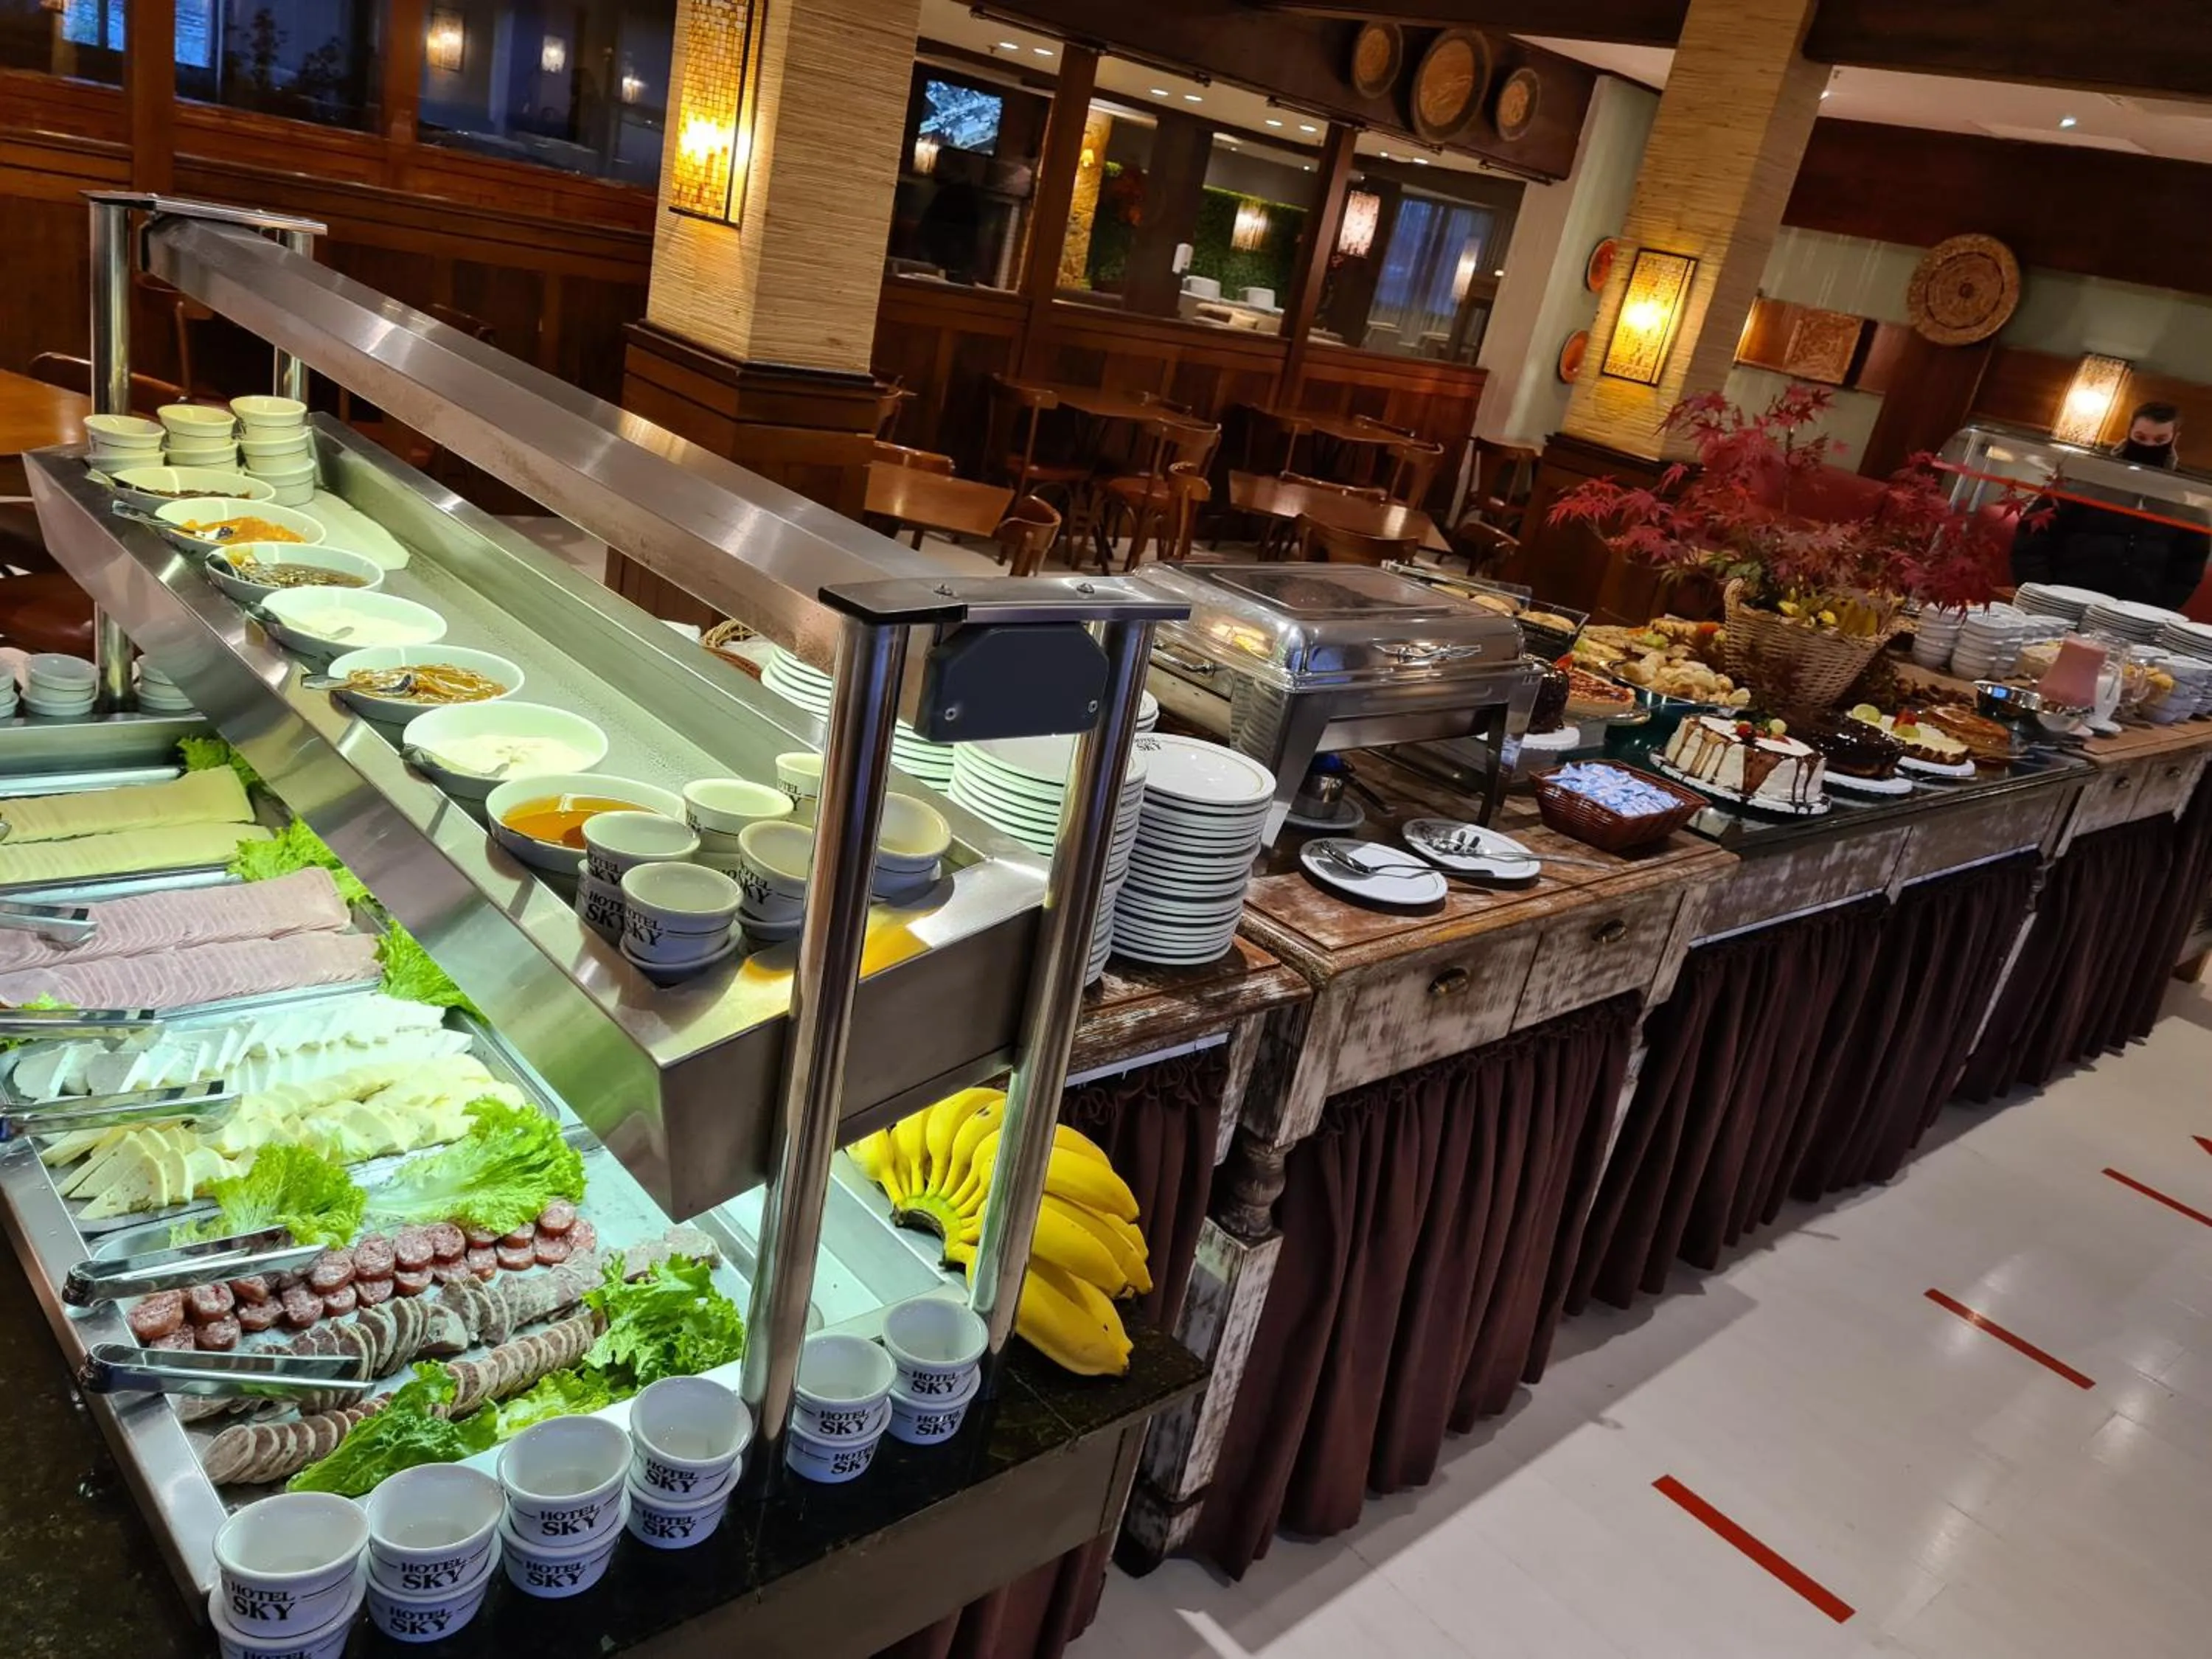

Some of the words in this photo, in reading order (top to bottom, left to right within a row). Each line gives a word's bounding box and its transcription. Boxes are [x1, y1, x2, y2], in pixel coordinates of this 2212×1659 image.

[778, 779, 802, 796] OTEL
[589, 891, 625, 913] HOTE
[911, 1371, 960, 1382] HOTEL
[911, 1380, 958, 1394] SKY
[820, 1410, 870, 1420] HOTEL
[819, 1416, 868, 1435] SKY
[647, 1458, 700, 1479] HOTEL
[644, 1470, 699, 1492] SKY
[540, 1505, 600, 1520] HOTEL
[642, 1510, 697, 1526] HOTEL
[541, 1510, 600, 1536] SKY
[642, 1520, 697, 1538] SKY
[401, 1557, 468, 1573] HOTEL
[526, 1560, 586, 1574] HOTEL
[403, 1564, 466, 1590] SKY
[526, 1568, 586, 1587] SKY
[231, 1582, 296, 1603] HOTEL
[232, 1596, 295, 1621] SKY
[389, 1606, 453, 1621] HOTEL
[390, 1614, 454, 1635] SKY
